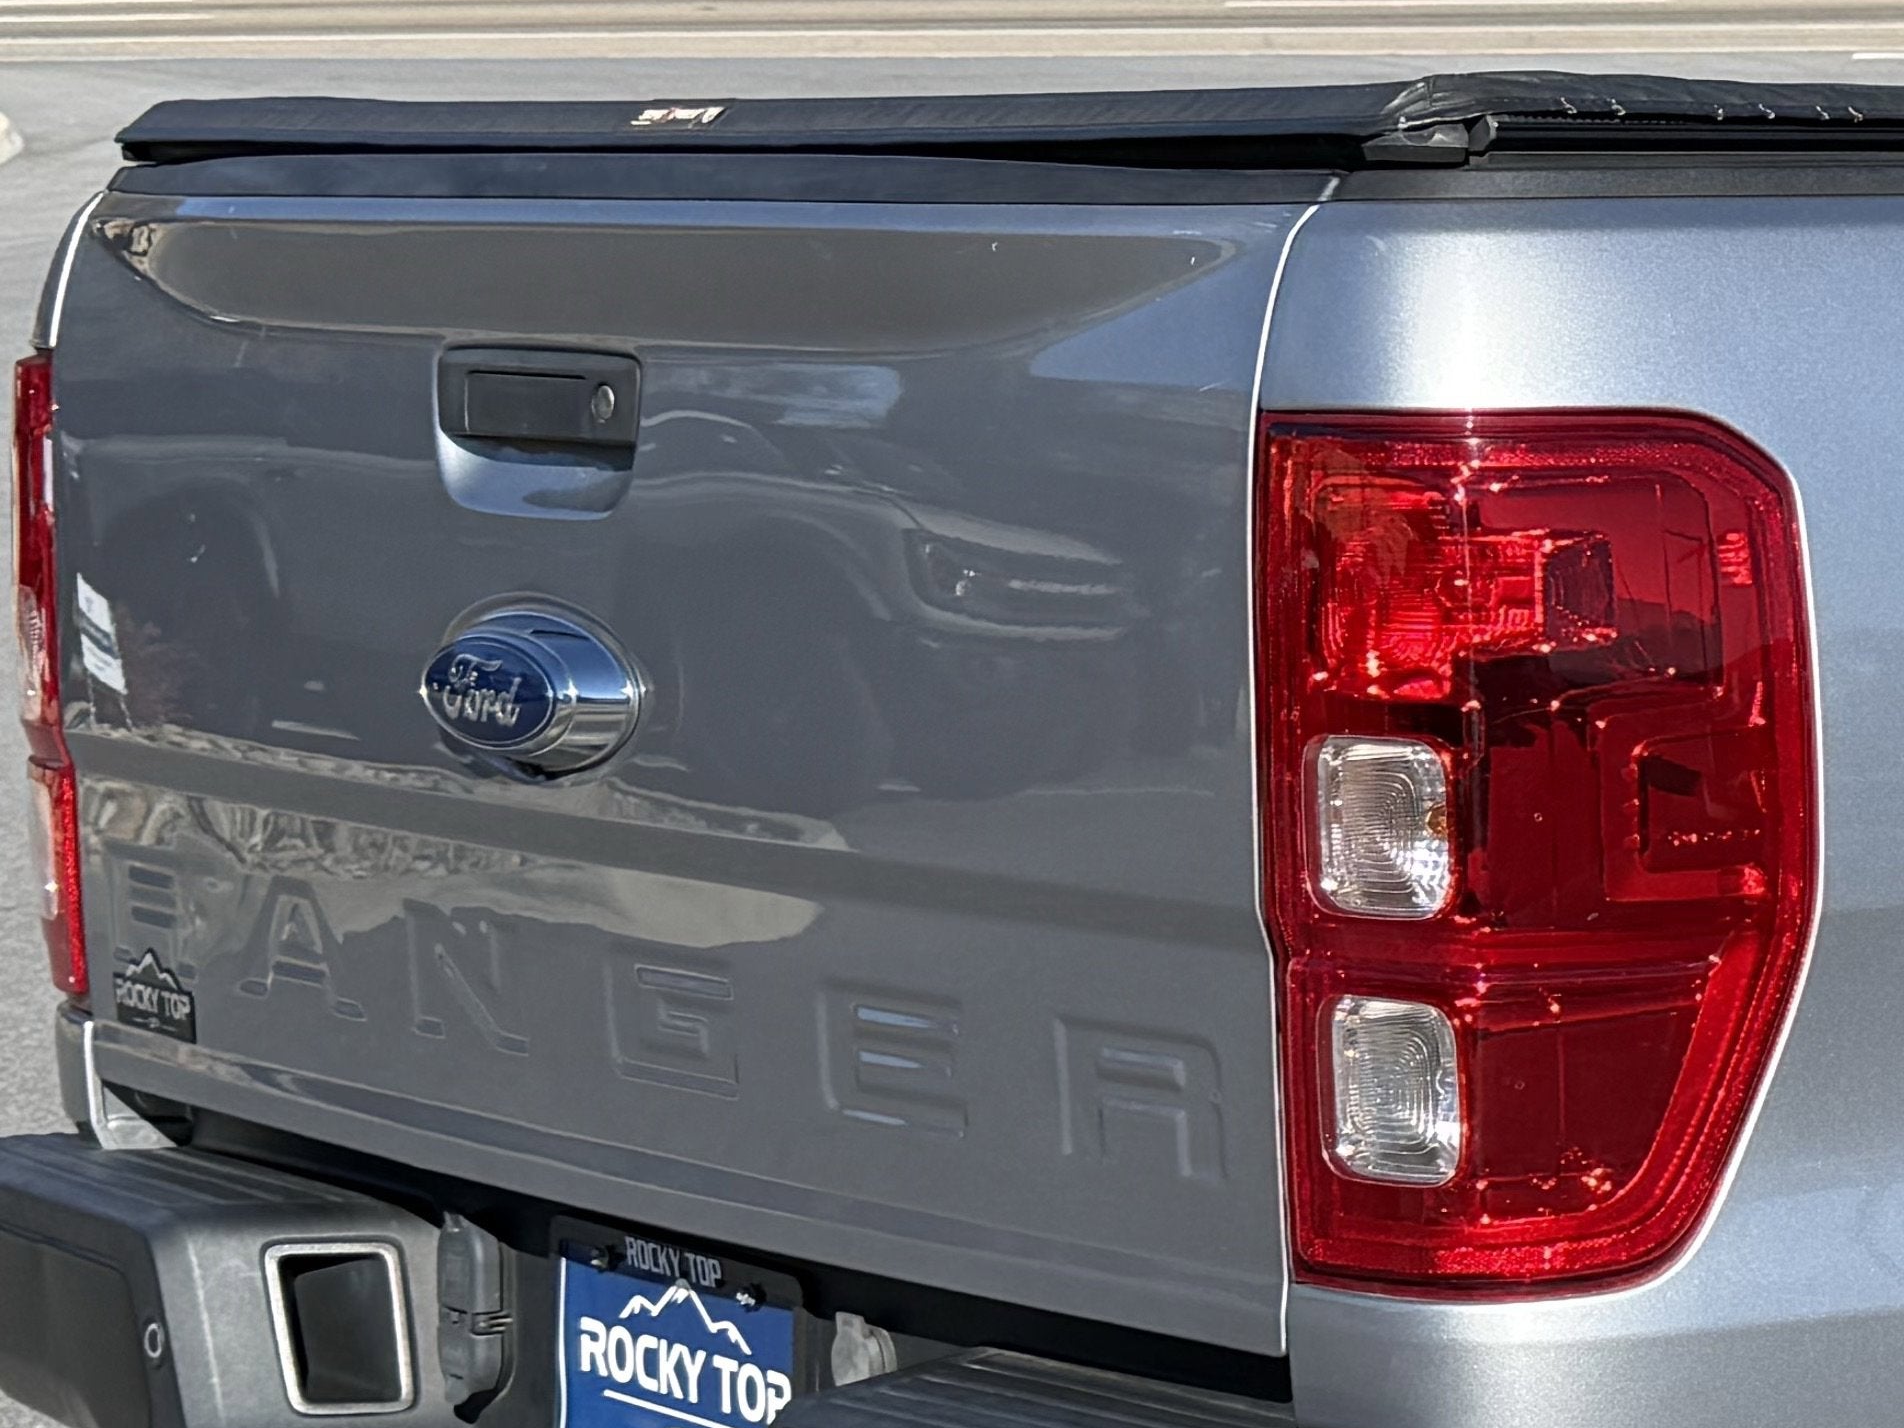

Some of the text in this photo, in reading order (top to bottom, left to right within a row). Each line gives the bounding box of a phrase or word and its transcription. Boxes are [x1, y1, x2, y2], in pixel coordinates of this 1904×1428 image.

[443, 653, 523, 728] Ford
[105, 840, 1230, 1180] RANGER
[115, 977, 191, 1021] ROCKY TOP
[624, 1235, 722, 1288] ROCKY TOP
[579, 1316, 793, 1426] ROCKY TOP
